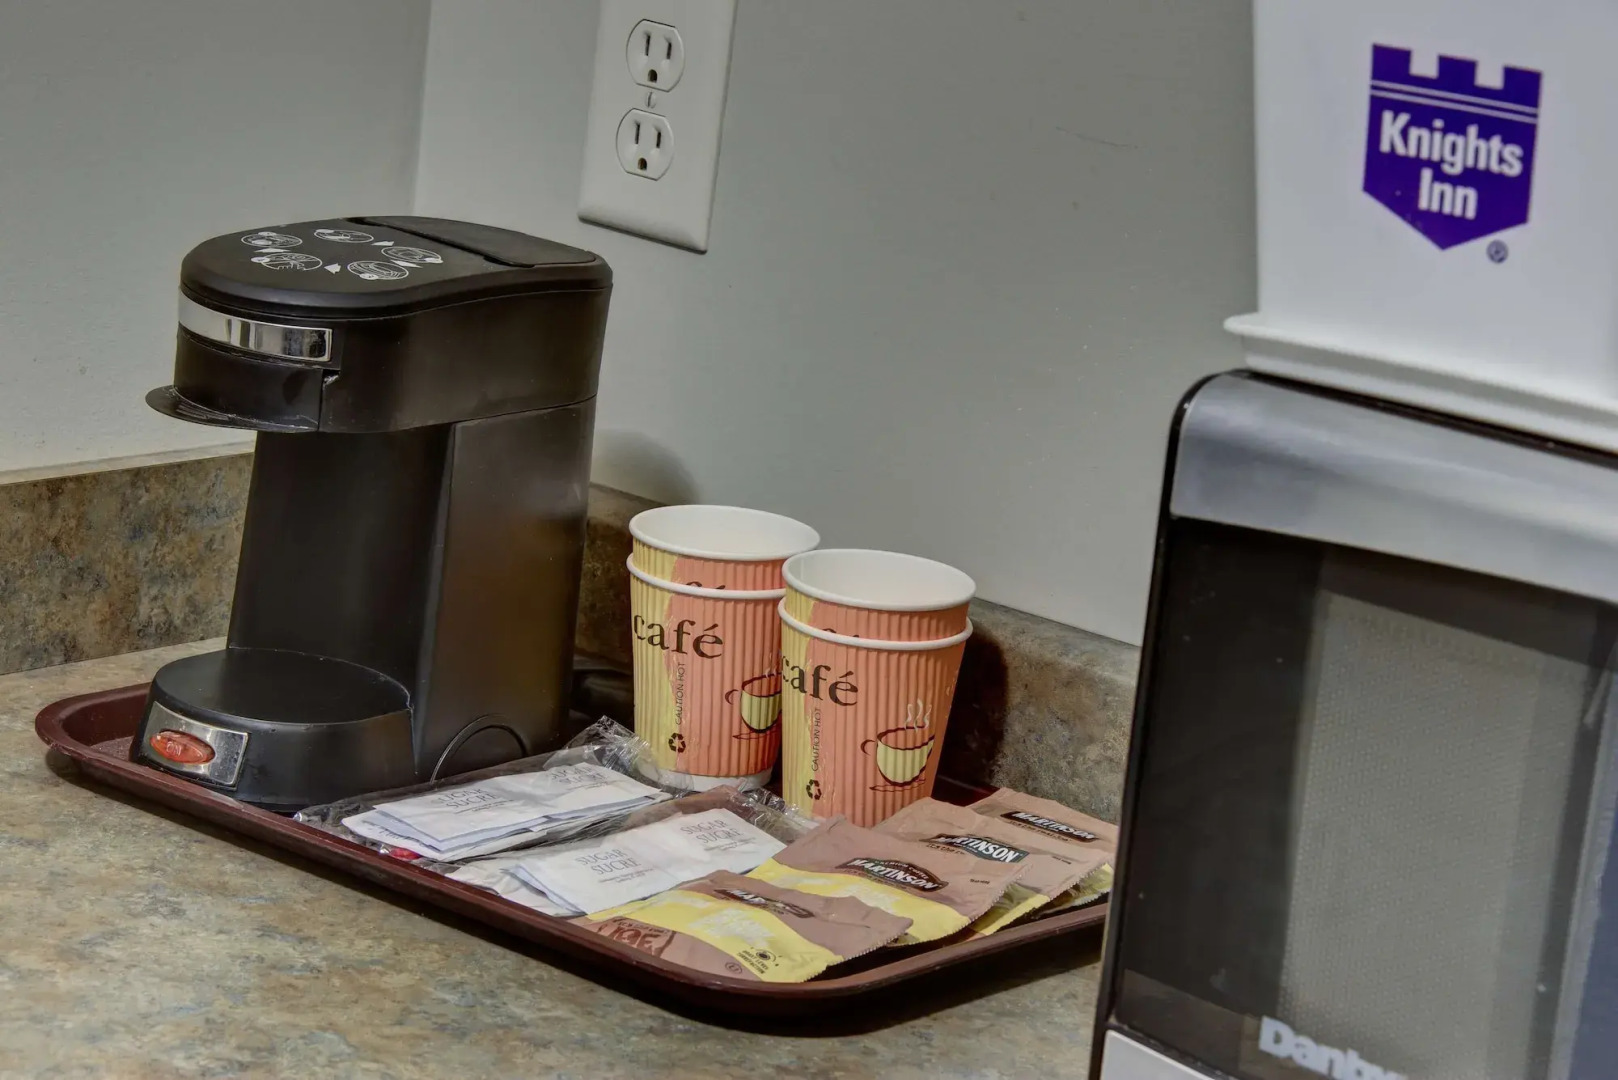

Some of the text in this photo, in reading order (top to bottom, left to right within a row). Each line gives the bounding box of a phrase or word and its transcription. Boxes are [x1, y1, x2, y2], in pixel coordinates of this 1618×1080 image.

[1379, 110, 1524, 177] Knights
[1418, 167, 1478, 220] Inn
[633, 615, 723, 659] café
[676, 683, 685, 725] CAUTION
[812, 729, 820, 771] CAUTION
[680, 820, 727, 834] SUGAR
[696, 828, 744, 843] SUCRE
[1011, 812, 1095, 839] MARTINSON
[576, 849, 627, 865] SUGAR
[591, 858, 641, 874] SUCRE
[847, 859, 938, 889] MARTINSON
[1259, 1015, 1408, 1080] Danb
